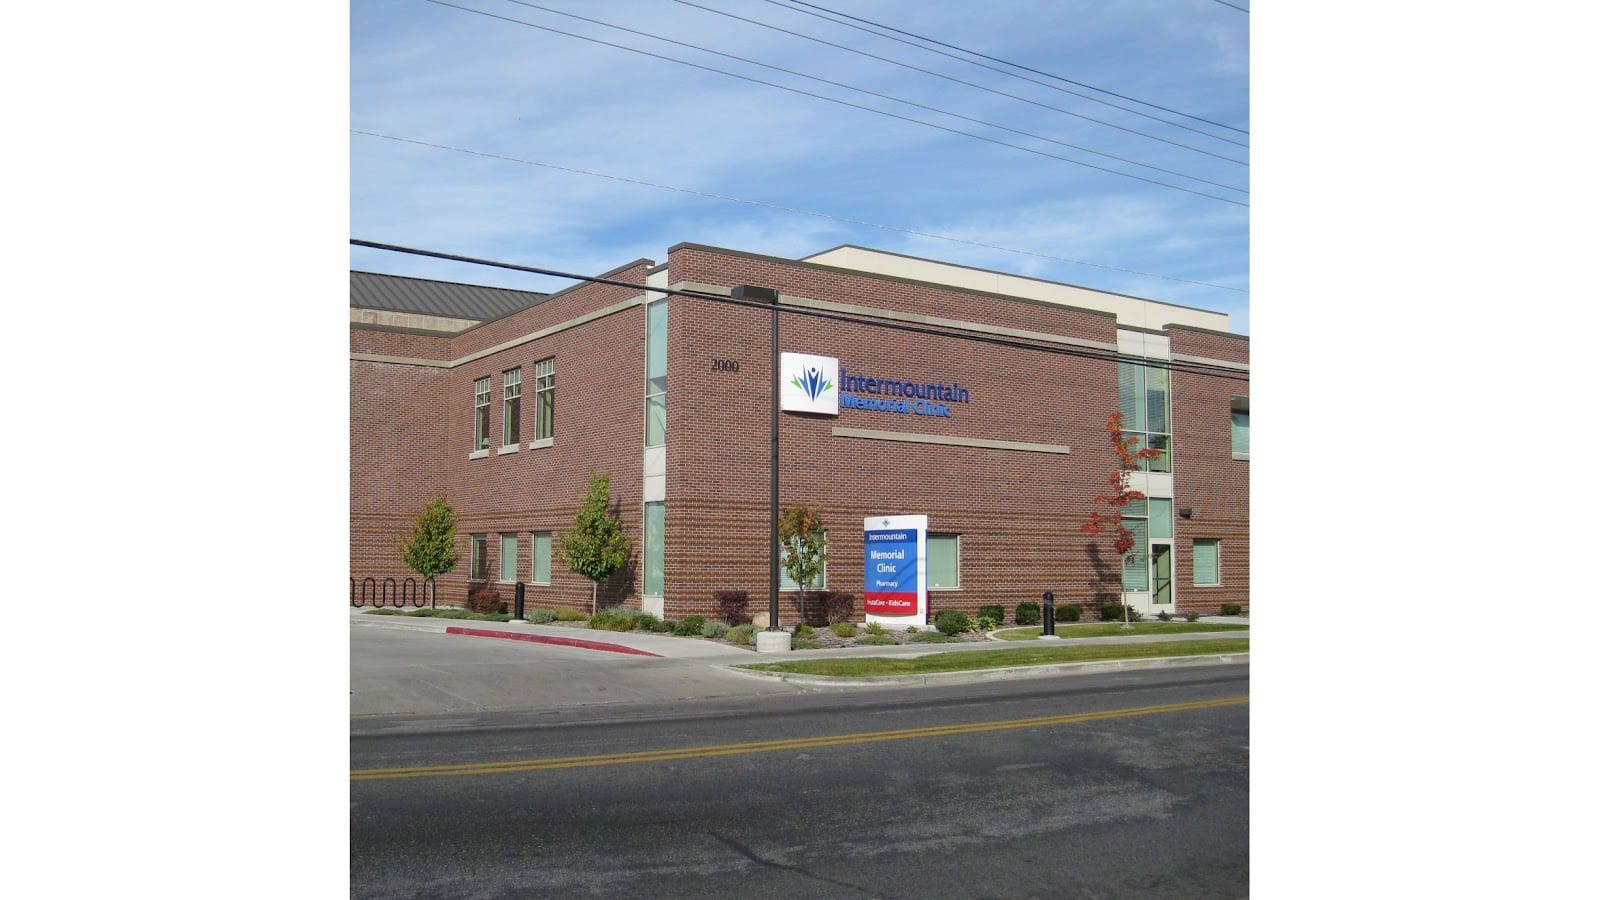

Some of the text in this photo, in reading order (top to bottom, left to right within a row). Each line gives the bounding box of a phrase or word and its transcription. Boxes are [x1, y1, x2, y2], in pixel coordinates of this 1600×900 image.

[711, 358, 740, 373] 2000
[840, 370, 969, 403] Intermountain
[840, 392, 951, 418] Memorial Clinic
[869, 532, 907, 541] Intermountain
[870, 549, 905, 560] Memorial
[877, 563, 896, 573] Clinic
[876, 580, 898, 588] Pharmacy
